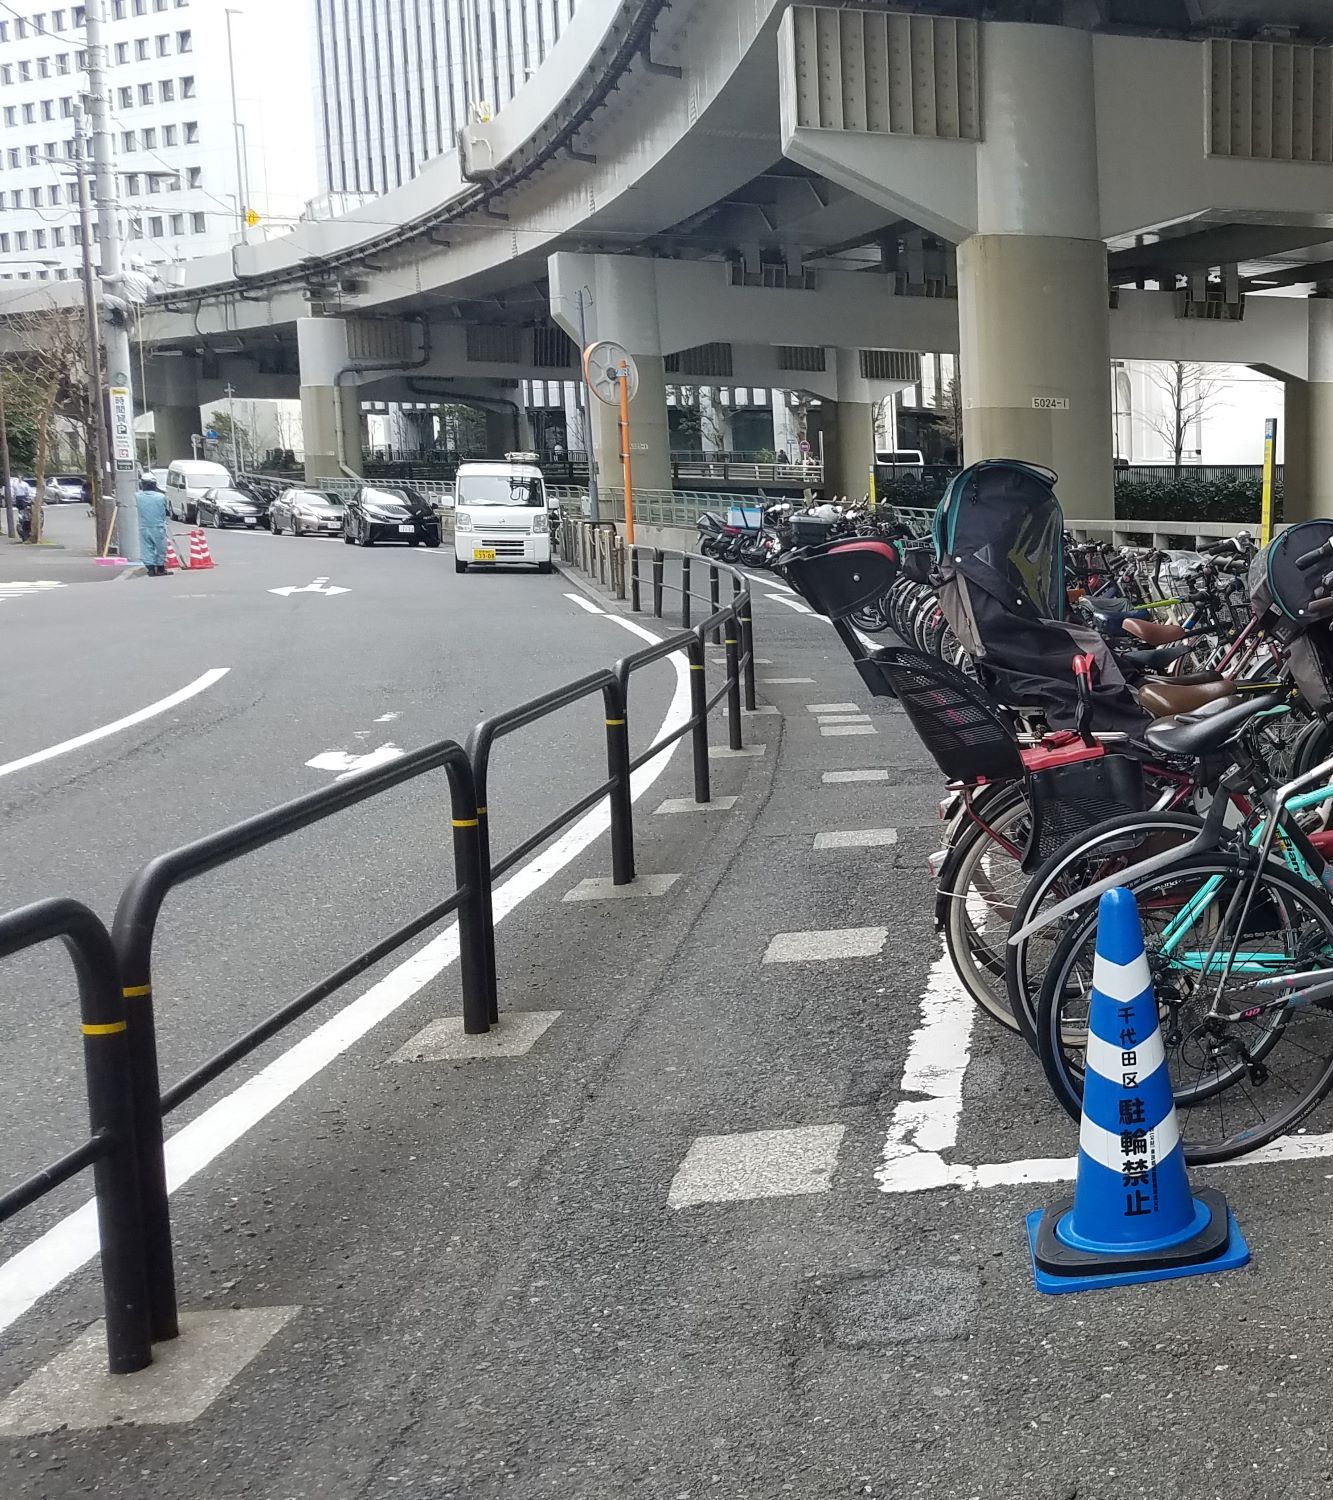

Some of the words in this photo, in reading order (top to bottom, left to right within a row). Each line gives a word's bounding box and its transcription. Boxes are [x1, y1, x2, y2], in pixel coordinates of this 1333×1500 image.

[1117, 1006, 1138, 1089] 千代田区
[1119, 1098, 1152, 1217] 駐輪禁止
